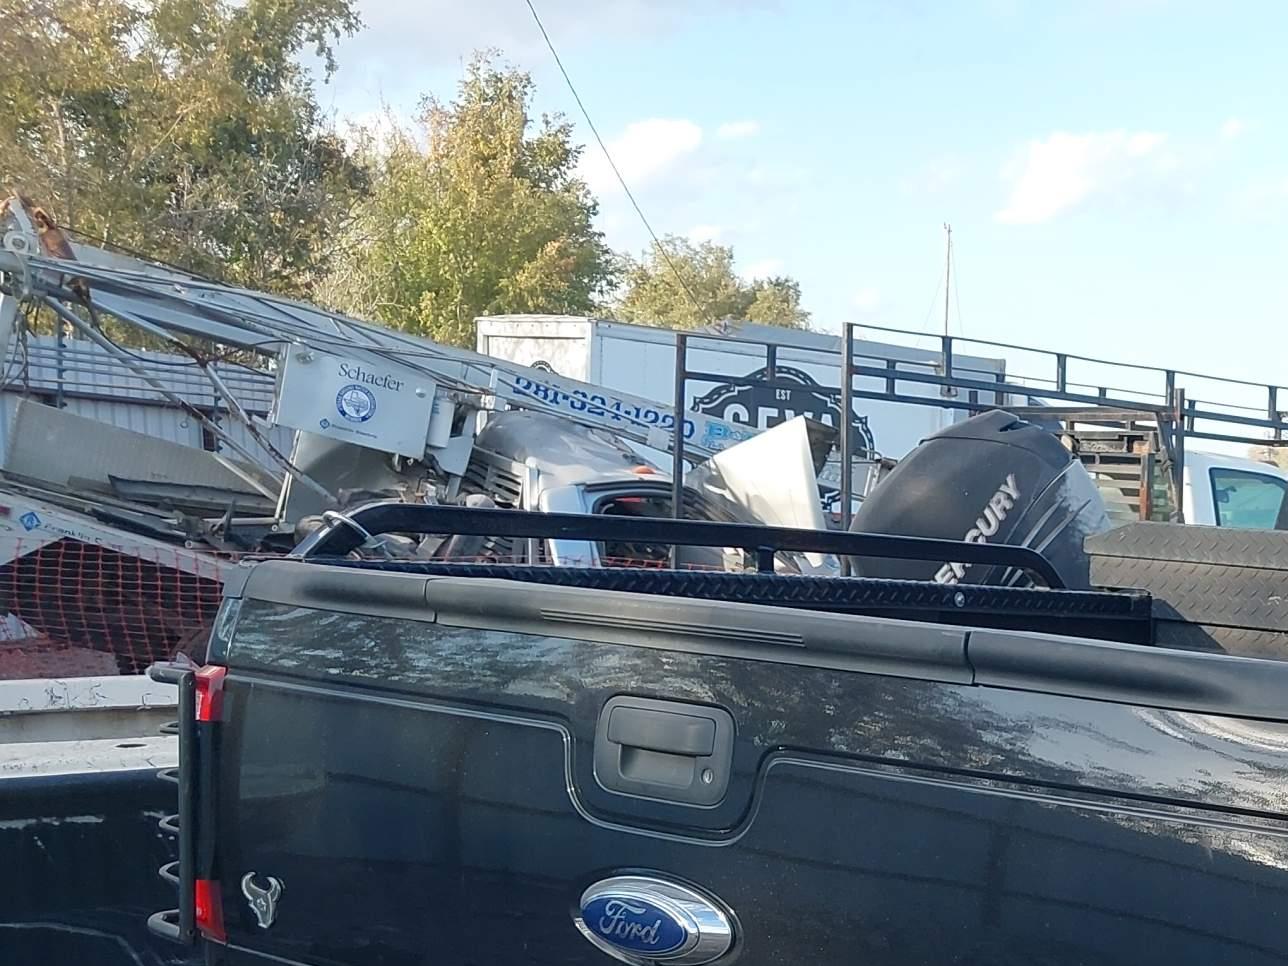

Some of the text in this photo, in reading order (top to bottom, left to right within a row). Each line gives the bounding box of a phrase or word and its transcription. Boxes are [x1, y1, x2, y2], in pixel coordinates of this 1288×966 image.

[338, 362, 404, 392] Schaefer
[775, 389, 791, 401] EST
[600, 900, 662, 945] Ford
